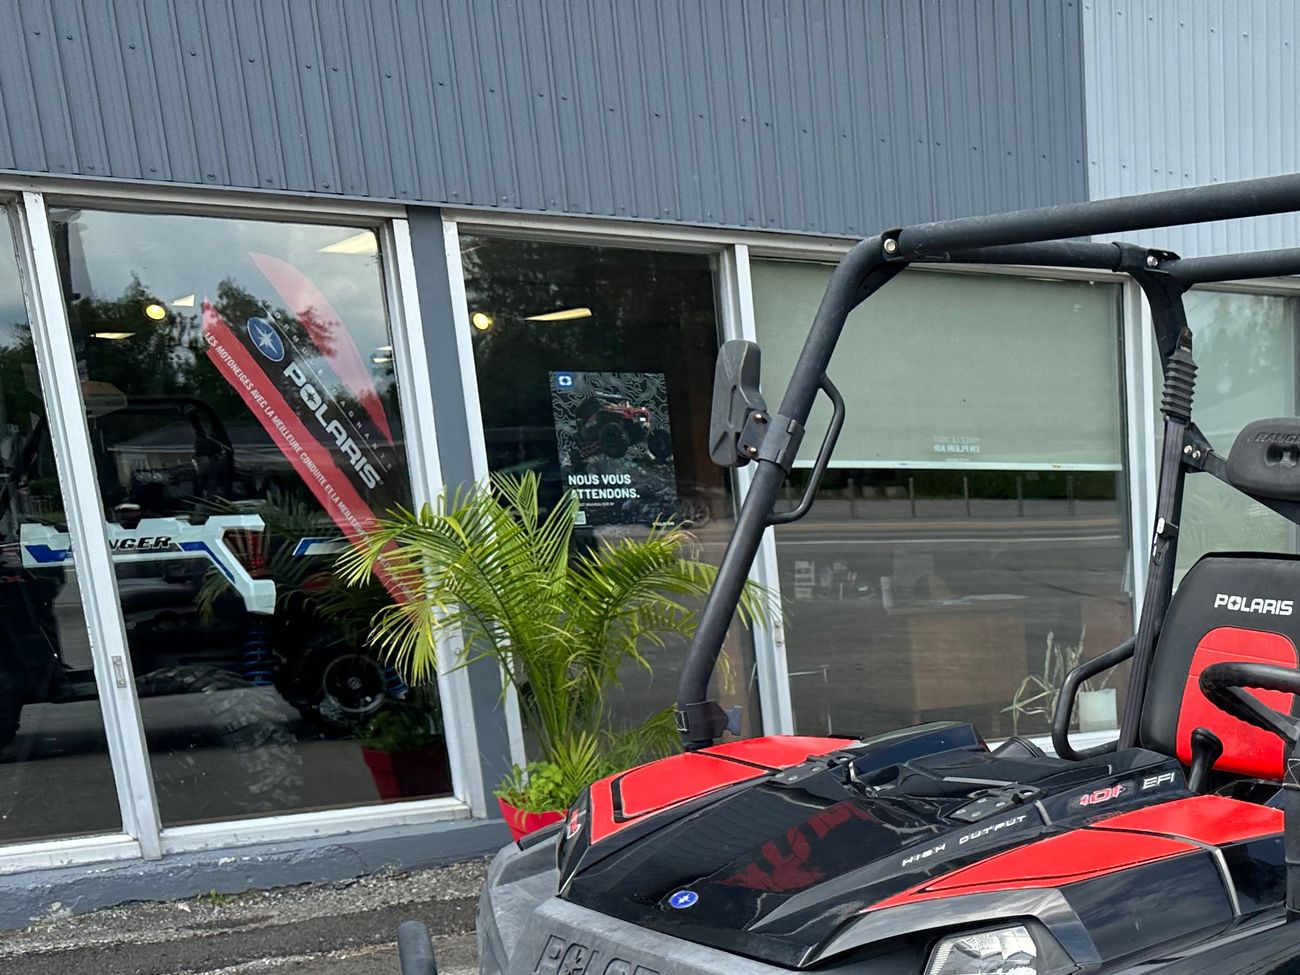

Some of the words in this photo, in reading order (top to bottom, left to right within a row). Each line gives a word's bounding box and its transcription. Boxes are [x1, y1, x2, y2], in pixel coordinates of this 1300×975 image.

[203, 331, 219, 347] LES
[214, 343, 254, 391] MOTONEIGES
[249, 387, 267, 408] AVEC
[263, 405, 275, 417] LA
[270, 414, 303, 454] MEILLEURE
[298, 451, 328, 487] CONDUITE
[323, 483, 334, 495] ET
[329, 492, 341, 504] LA
[280, 361, 384, 489] POLARIS
[568, 475, 599, 485] NOUS
[601, 474, 631, 485] VOUS
[1214, 593, 1294, 616] POLARIS
[1143, 772, 1175, 790] EFI
[902, 843, 946, 867] HIGH
[959, 814, 1026, 845] OUTPUT
